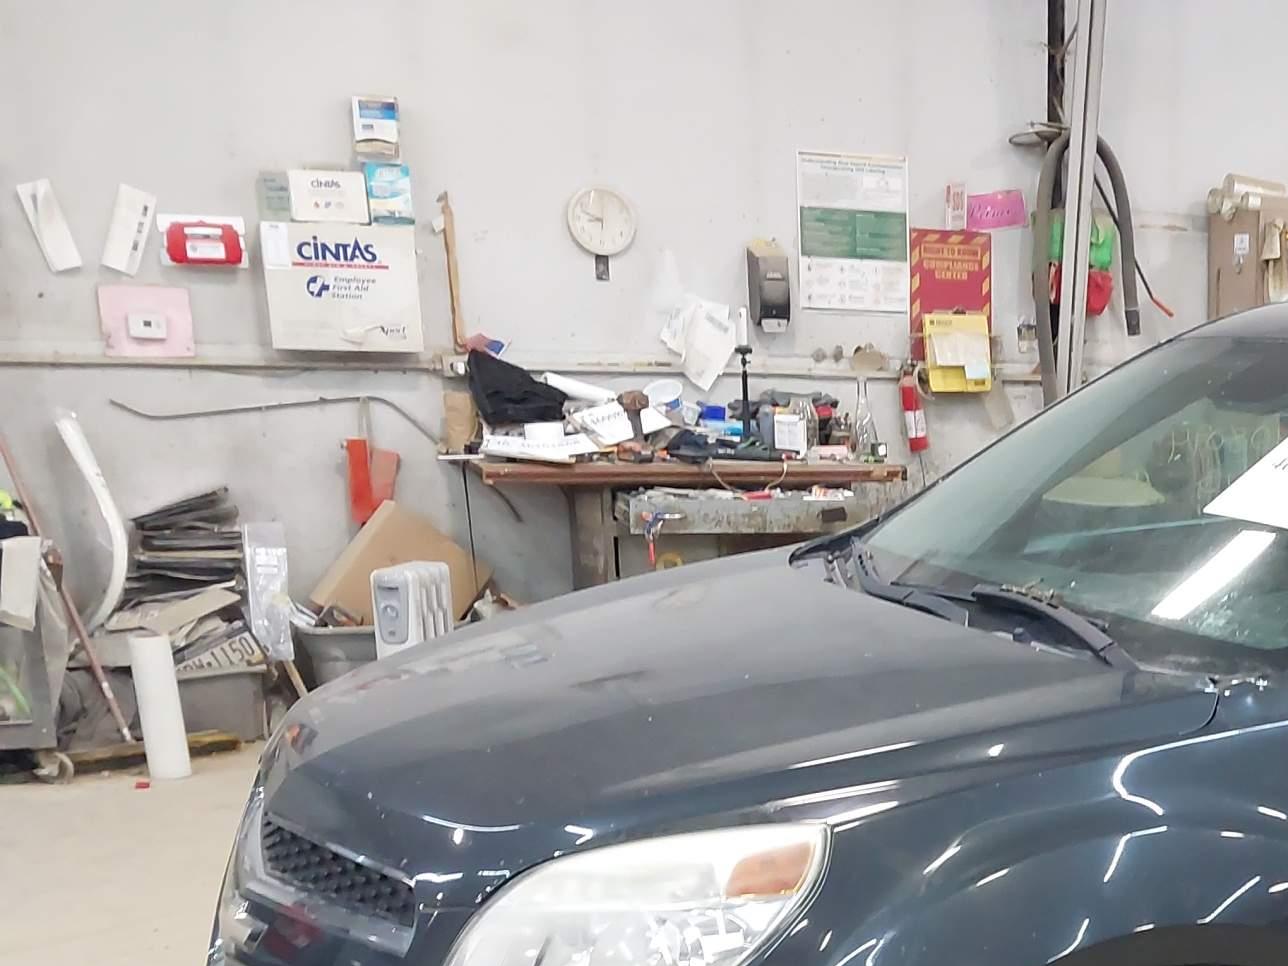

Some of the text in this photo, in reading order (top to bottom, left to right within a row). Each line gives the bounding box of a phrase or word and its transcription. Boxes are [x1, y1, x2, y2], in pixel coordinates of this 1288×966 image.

[946, 247, 956, 257] TO
[334, 276, 377, 286] Employee
[332, 284, 370, 293] First Aid
[331, 292, 363, 300] Station
